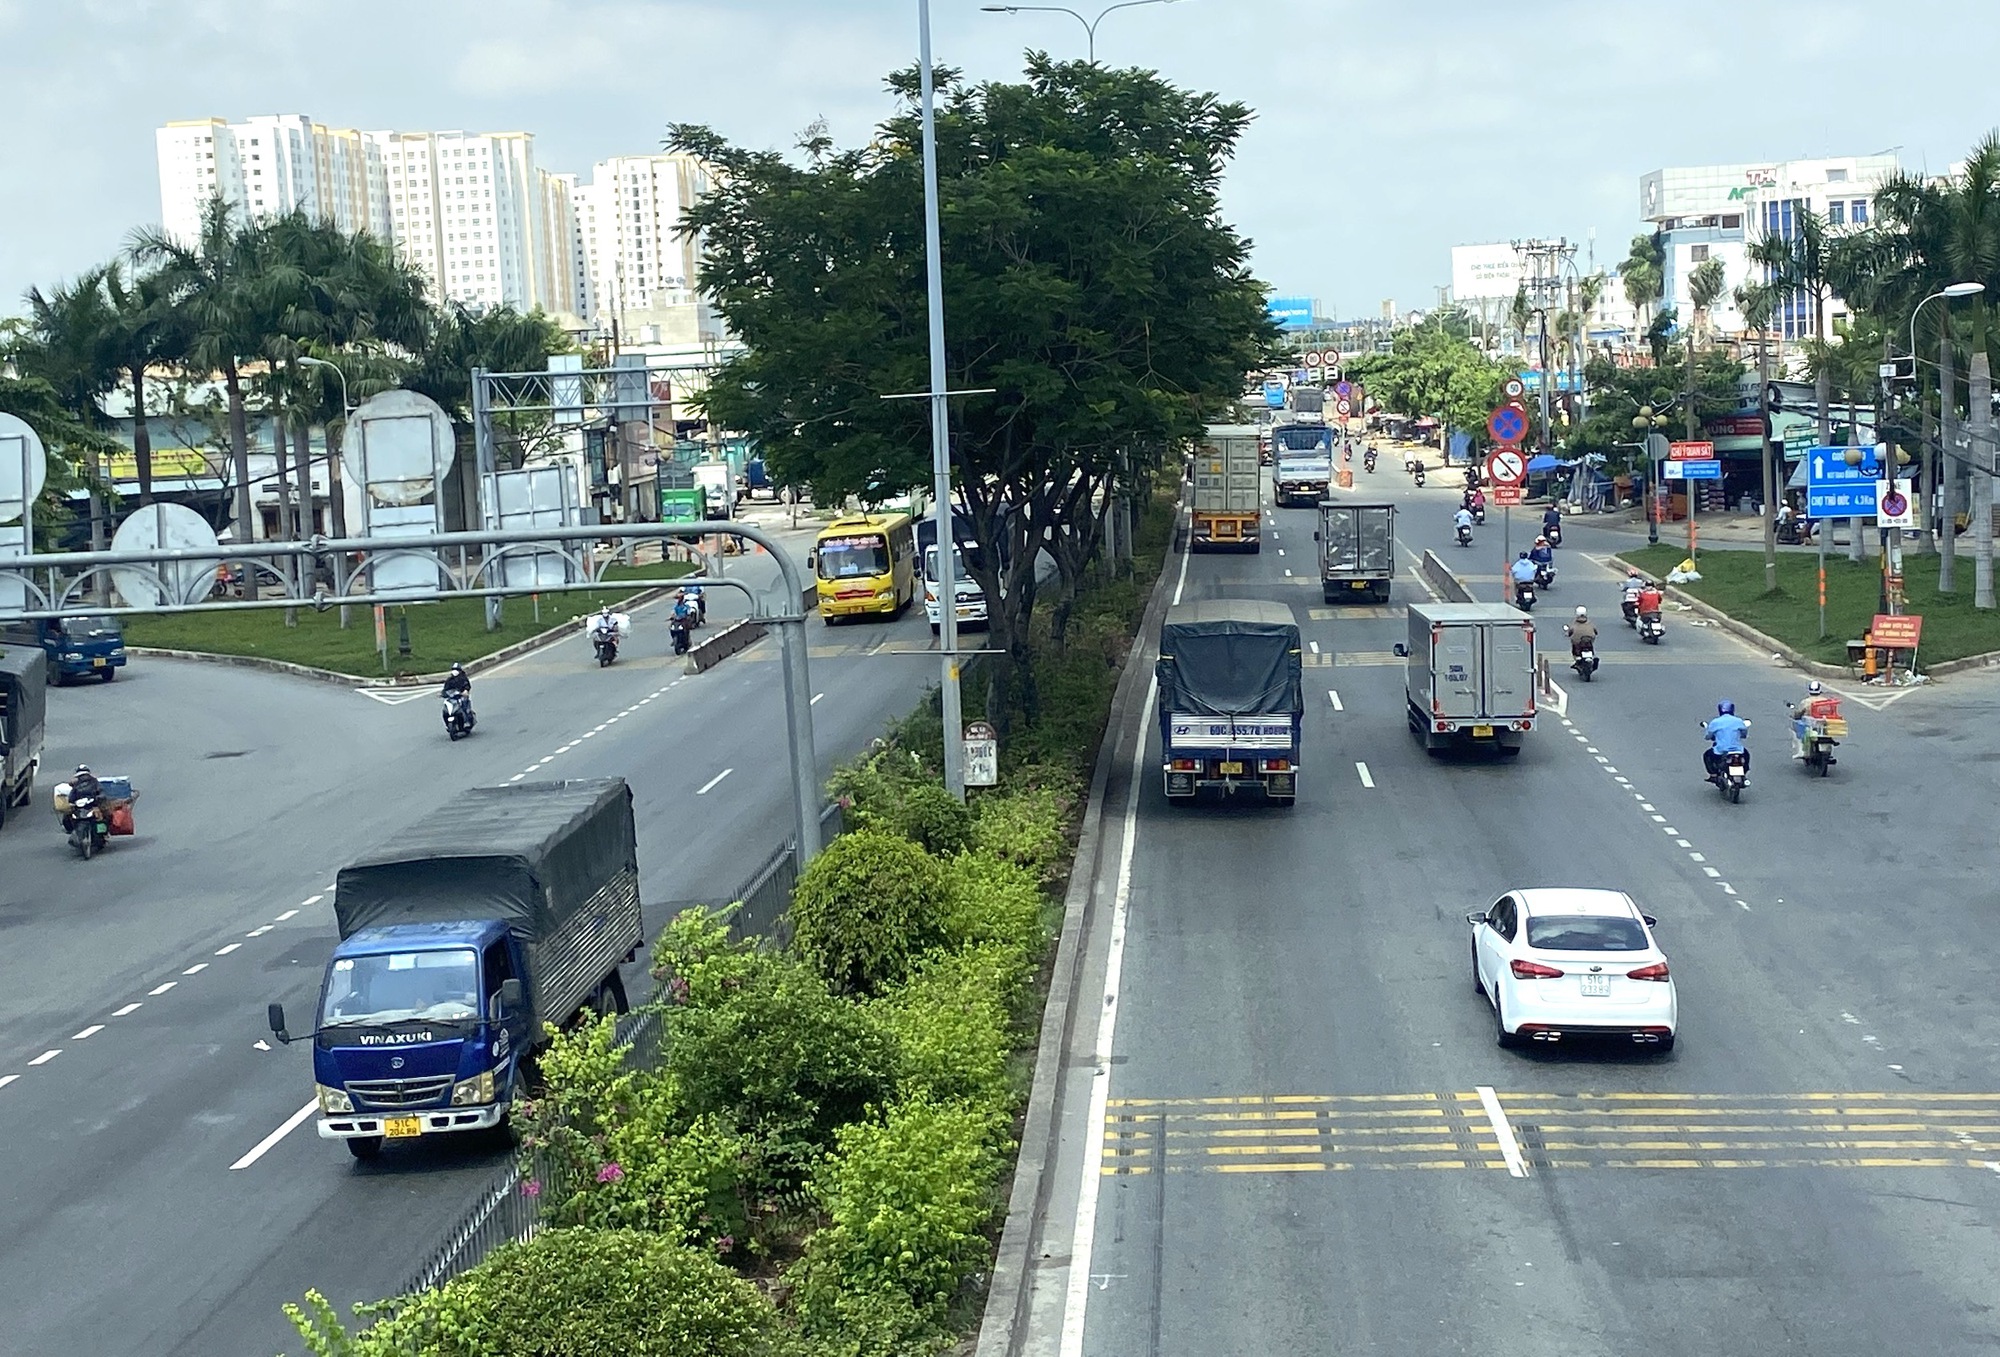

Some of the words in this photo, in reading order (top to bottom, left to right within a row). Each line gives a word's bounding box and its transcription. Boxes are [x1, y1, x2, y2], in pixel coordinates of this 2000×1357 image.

[1509, 384, 1519, 393] 50
[1886, 482, 1901, 490] ZNE
[1811, 495, 1823, 506] CHỢ
[1824, 493, 1836, 505] THỦ
[1837, 493, 1850, 505] ĐỨC
[360, 1031, 432, 1045] VINAXUKI
